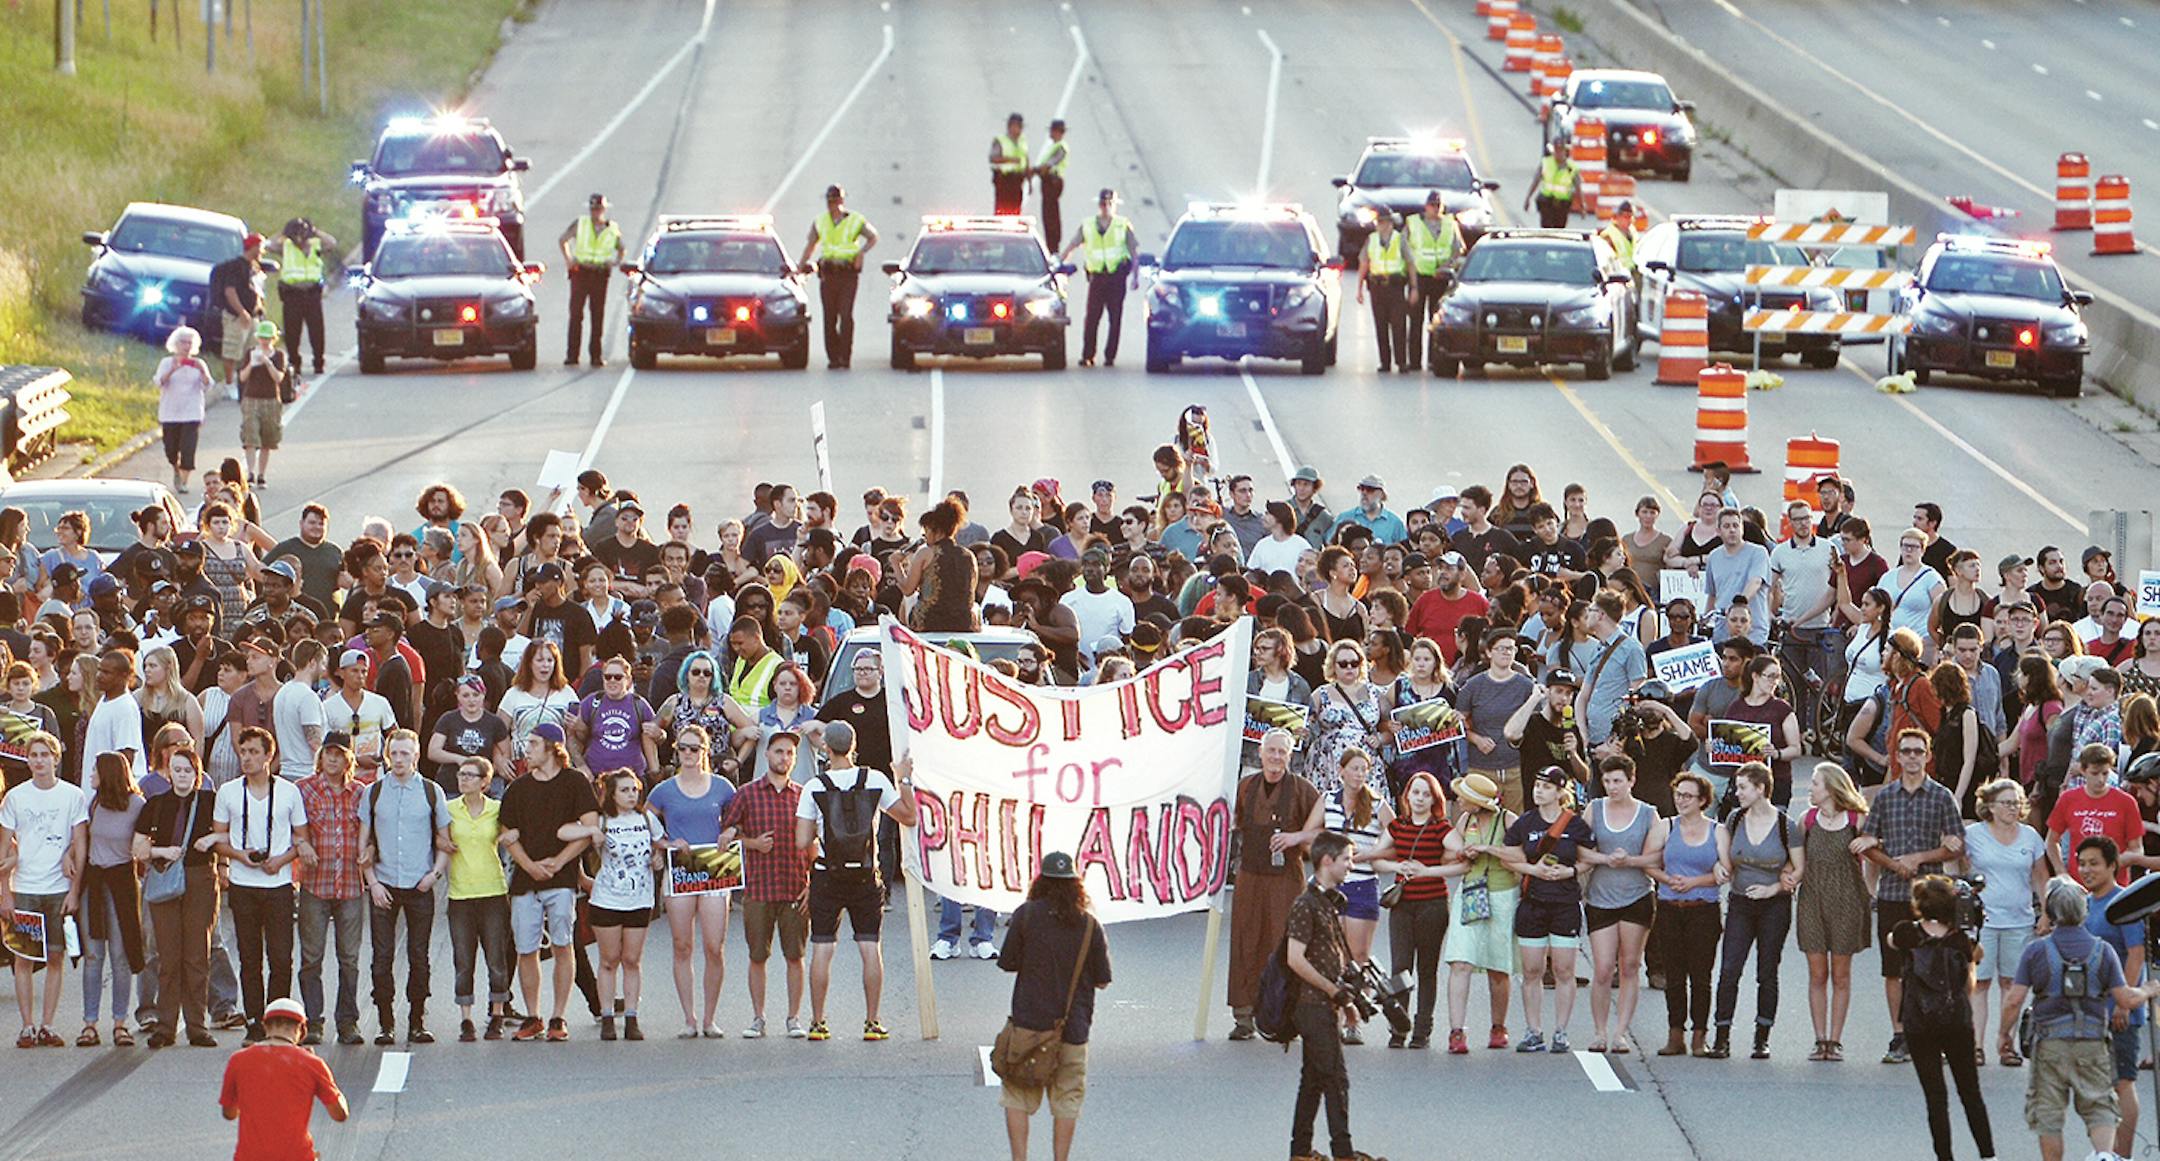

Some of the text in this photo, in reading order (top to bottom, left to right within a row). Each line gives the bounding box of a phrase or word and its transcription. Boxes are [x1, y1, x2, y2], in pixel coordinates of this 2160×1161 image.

[1660, 655, 1714, 682] SHAME
[1399, 727, 1431, 742] STAND
[1401, 727, 1458, 750] TOGETHER
[1712, 741, 1742, 754] STAND
[1012, 743, 1122, 806] for
[674, 871, 709, 884] STAND
[674, 876, 738, 893] TOGETHER
